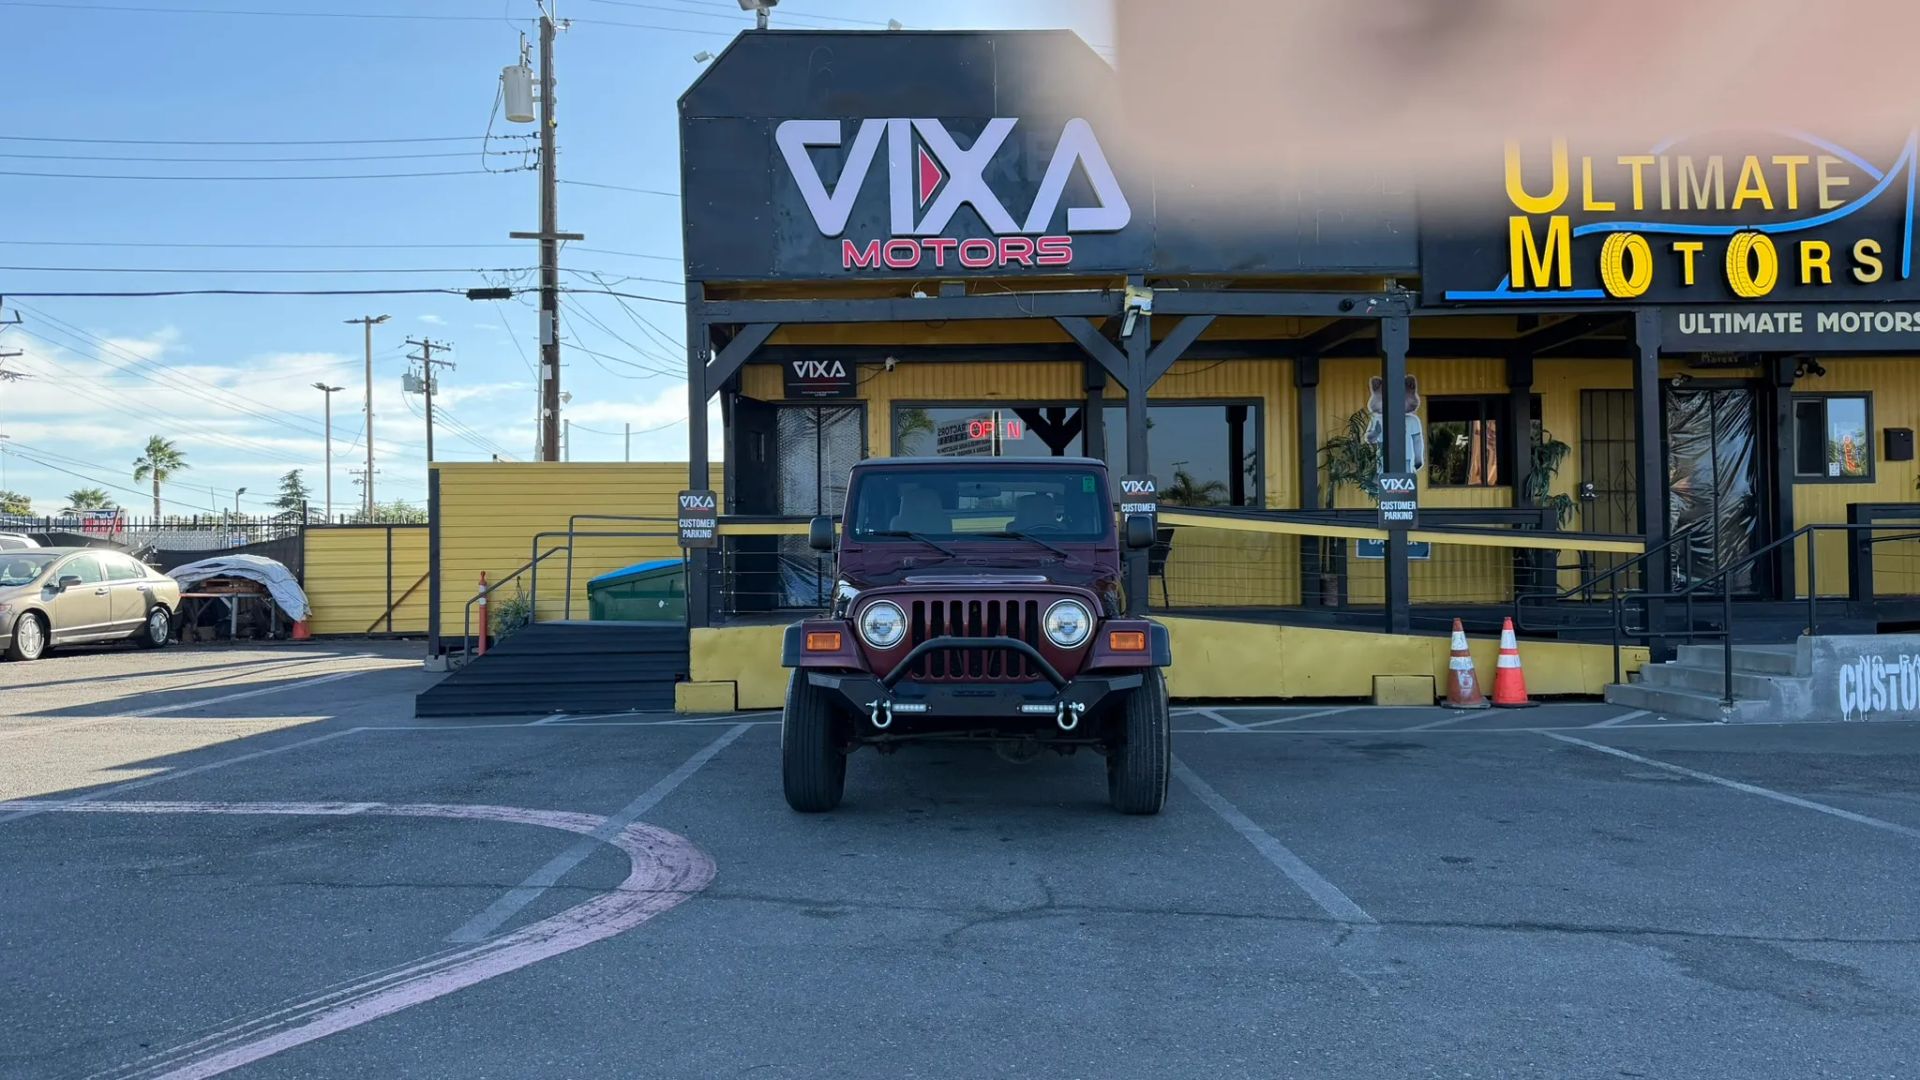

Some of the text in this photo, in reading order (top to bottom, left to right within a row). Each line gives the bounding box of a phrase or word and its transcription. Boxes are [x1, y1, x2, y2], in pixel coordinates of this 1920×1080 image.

[775, 117, 1132, 237] VIXA
[1504, 137, 1851, 214] ULTIMATE
[841, 236, 1073, 269] MOTORS
[1508, 214, 1884, 299] MOTORS
[1679, 311, 1920, 334] ULTIMATE MOTORS
[792, 360, 846, 378] VIXA
[1121, 480, 1155, 492] VIXA
[1380, 478, 1415, 490] VIXA
[680, 495, 715, 507] VIXA
[1380, 501, 1417, 510] CUSTOMER
[1121, 503, 1156, 512] CUSTOMER
[1384, 511, 1413, 520] PARKING
[679, 518, 716, 528] CUSTOMER
[682, 529, 712, 538] PARKING
[1839, 664, 1920, 714] CUSTO
